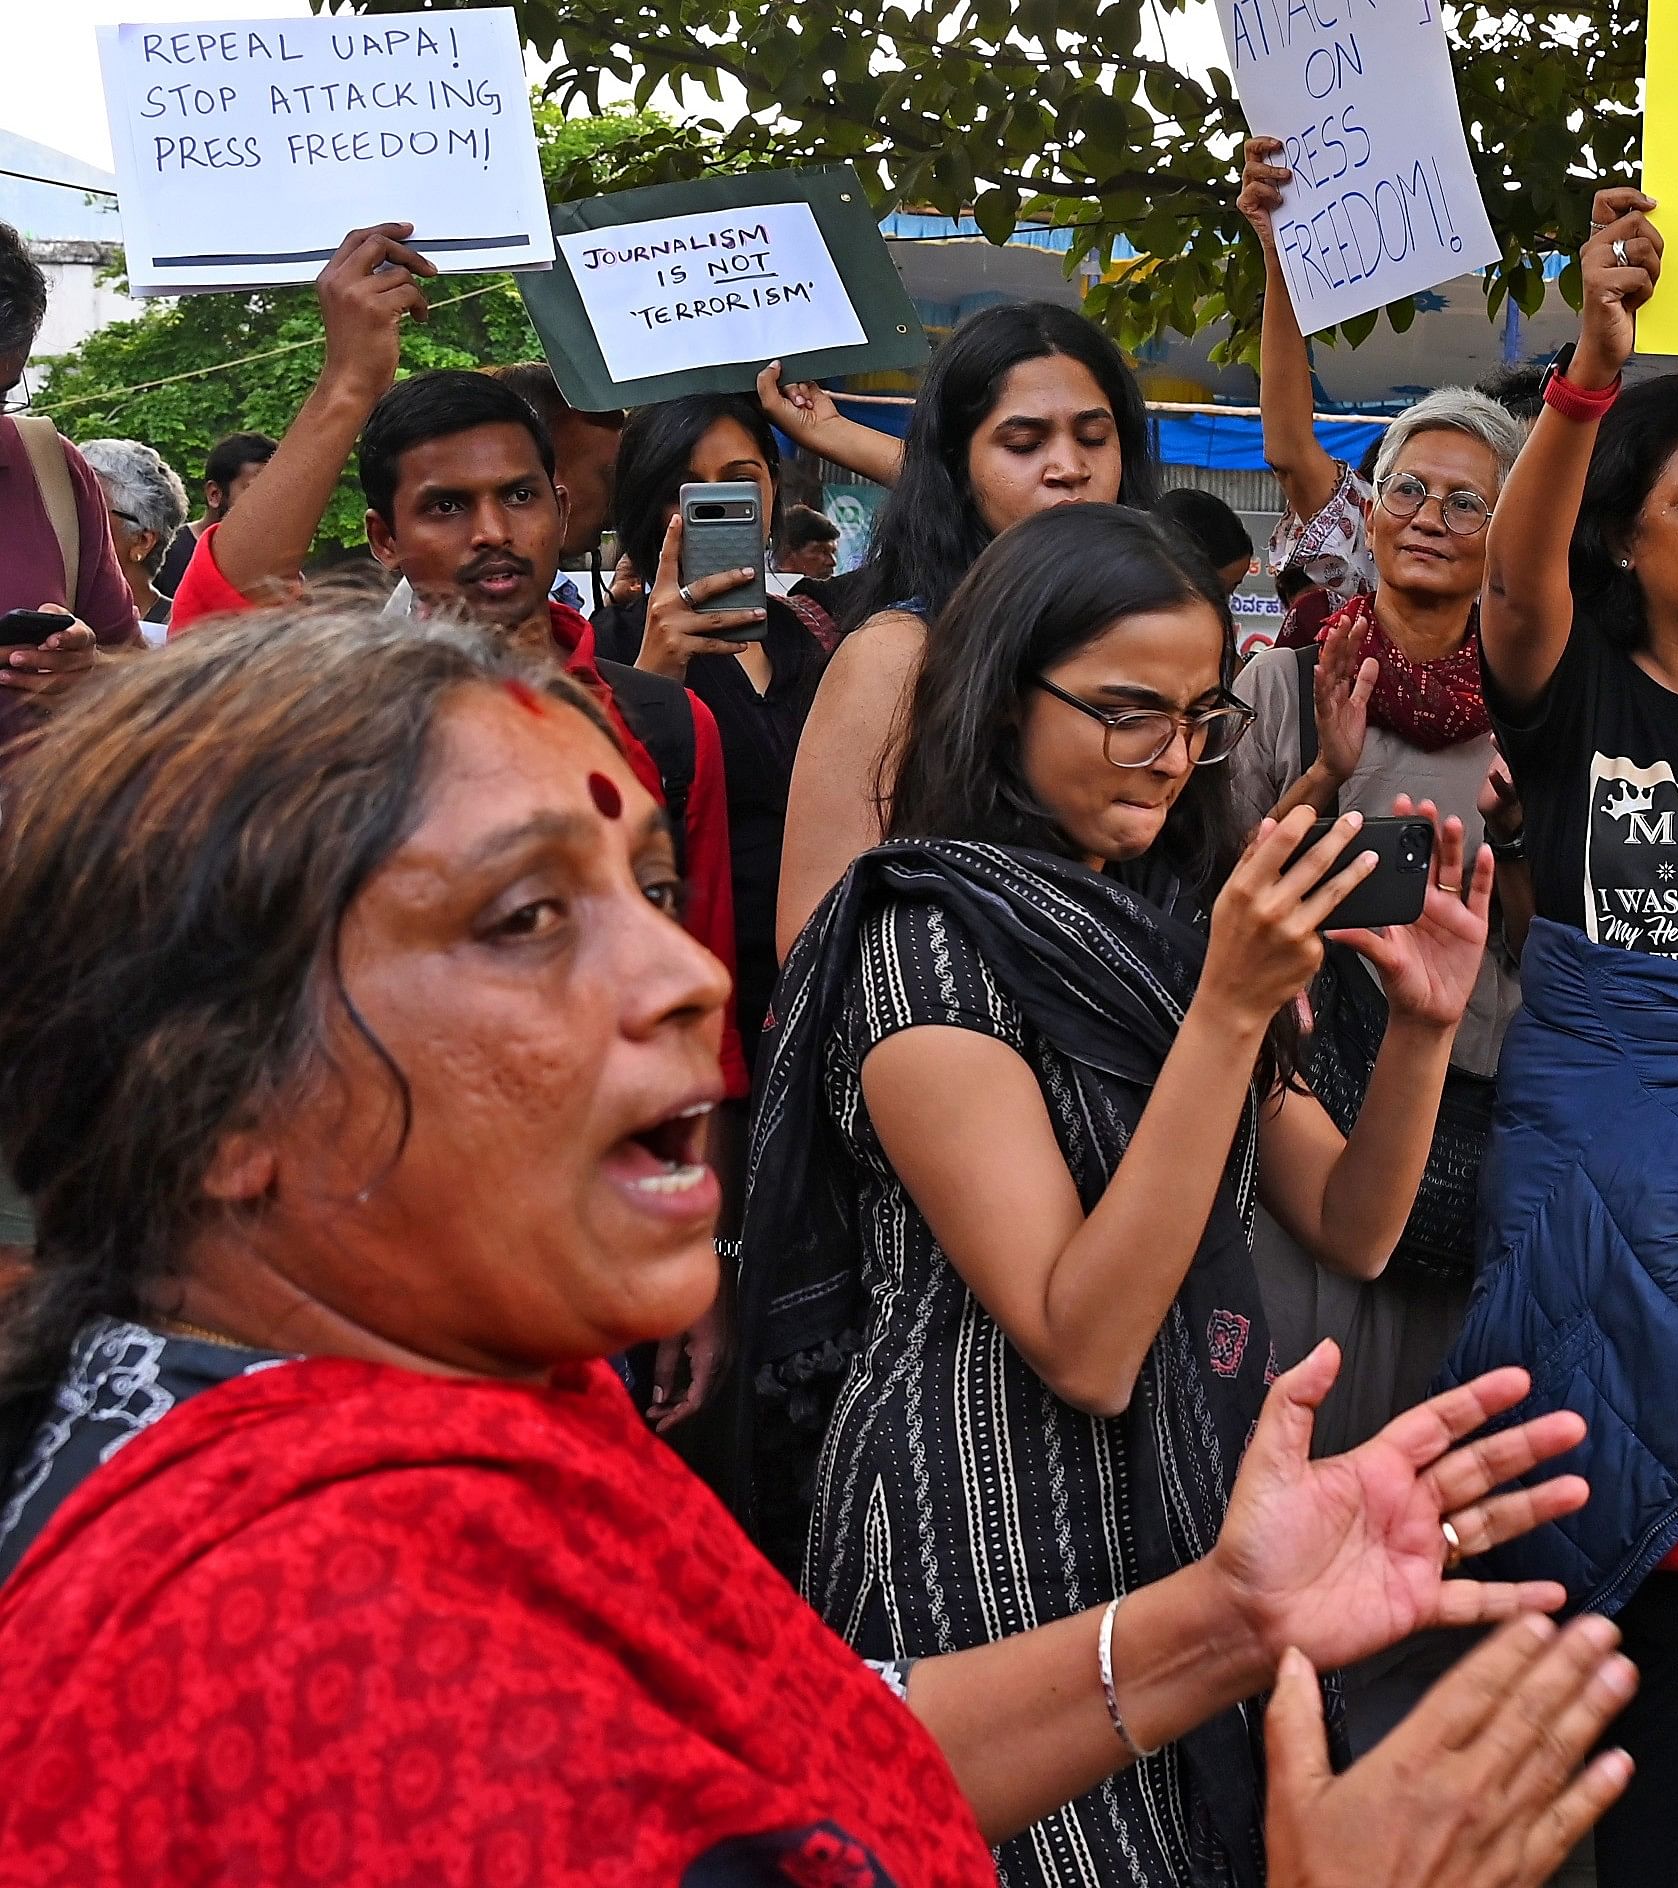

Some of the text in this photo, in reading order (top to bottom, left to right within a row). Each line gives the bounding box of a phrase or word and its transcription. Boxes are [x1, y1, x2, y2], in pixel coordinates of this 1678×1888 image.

[143, 27, 460, 68] REPEAL UAPA!
[1305, 33, 1362, 98] ON
[140, 79, 502, 118] STOP ATTACKING
[155, 128, 491, 171] PRESS FREEDOM!
[583, 224, 770, 269] JOURNALISM
[1279, 156, 1462, 302] FREEDOM!
[657, 252, 771, 287] IS NOT
[1598, 888, 1611, 912] I
[1599, 915, 1643, 950] My
